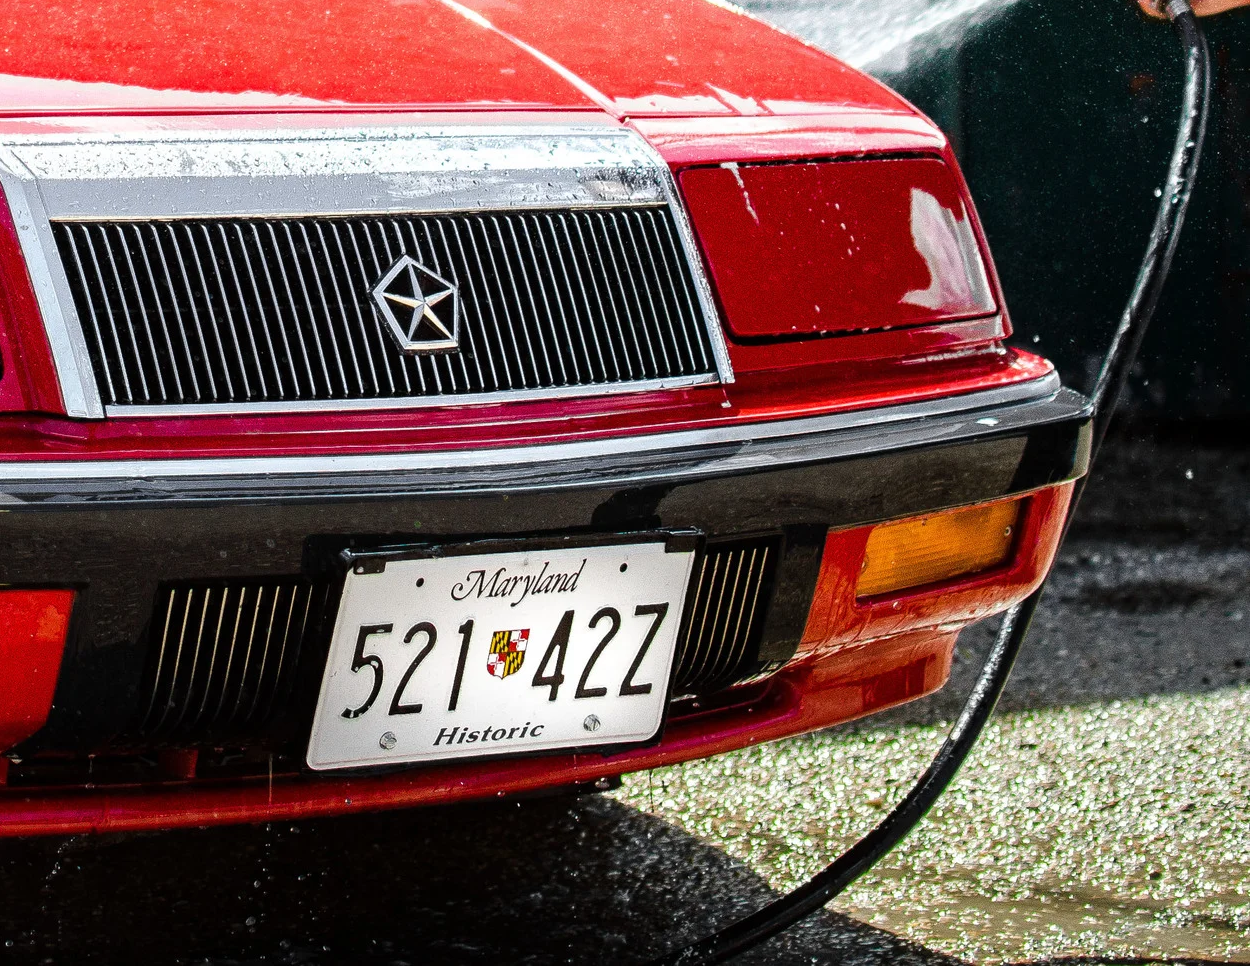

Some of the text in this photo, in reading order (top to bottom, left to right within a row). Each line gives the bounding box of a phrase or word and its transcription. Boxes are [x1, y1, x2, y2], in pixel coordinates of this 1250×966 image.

[451, 559, 587, 607] Maryland
[341, 619, 475, 719] 521
[432, 721, 545, 746] Historic
